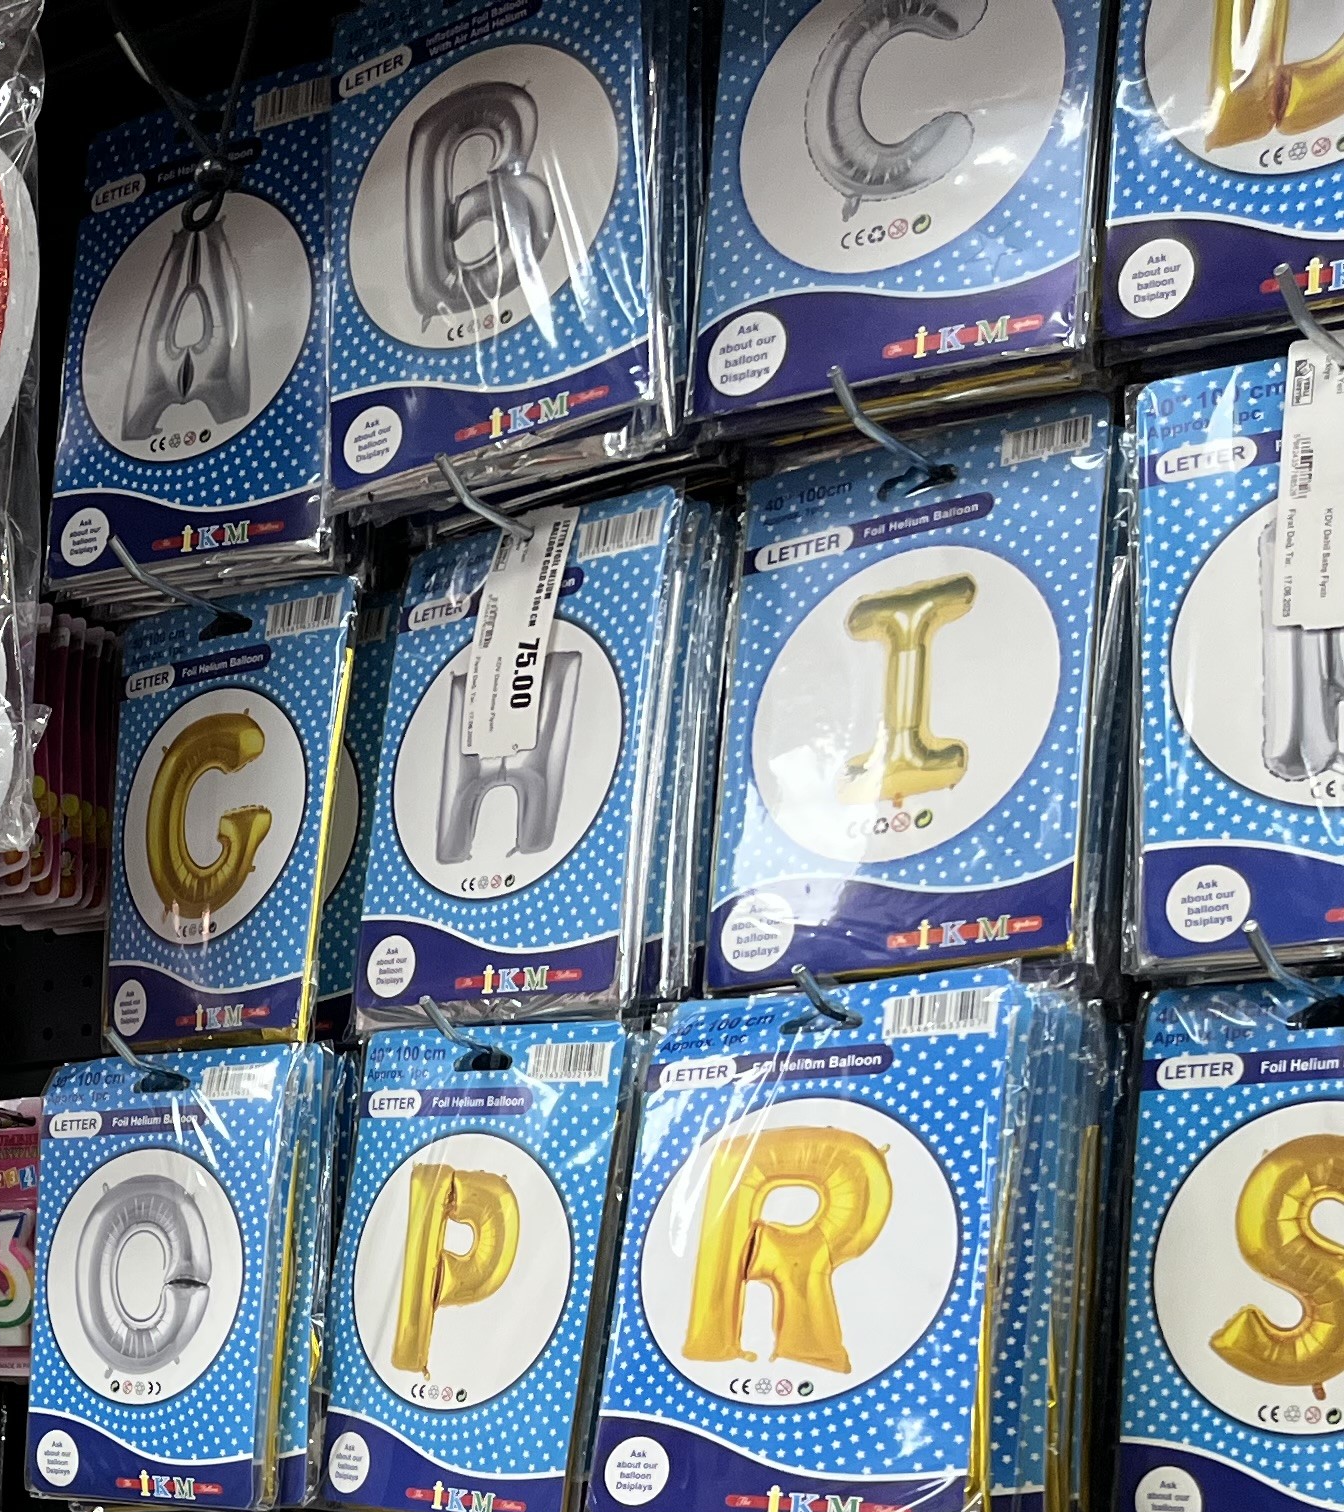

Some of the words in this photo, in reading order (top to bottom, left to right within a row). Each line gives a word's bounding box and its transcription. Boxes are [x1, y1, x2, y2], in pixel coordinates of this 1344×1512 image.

[345, 54, 404, 91] LETTER
[805, 0, 990, 221] C
[95, 181, 141, 206] LETTER
[405, 80, 555, 333] B
[1147, 254, 1166, 265] Ask
[1132, 267, 1161, 280] about
[1164, 264, 1181, 274] our
[1137, 276, 1174, 290] balloon
[121, 213, 252, 443] A
[737, 322, 760, 337] Ask
[719, 339, 753, 355] about
[756, 334, 777, 346] our
[724, 351, 768, 369] balloon
[1164, 446, 1245, 474] LETTER
[863, 524, 886, 538] Foil
[888, 513, 930, 533] Helium
[933, 501, 979, 522] Balloon
[766, 533, 841, 566] LETTER
[413, 602, 462, 624] LETTER
[230, 652, 264, 668] Balloon
[129, 672, 169, 692] LETTER
[510, 637, 541, 710] 75.00
[146, 708, 272, 922] G
[395, 1047, 419, 1061] 100
[423, 1049, 446, 1061] cm
[829, 1053, 882, 1068] Balloon
[666, 1064, 728, 1083] LETTER
[1164, 1061, 1234, 1080] LETTER
[1260, 1058, 1287, 1073] Foil
[1290, 1057, 1340, 1071] Helium
[372, 1097, 415, 1111] LETTER
[451, 1095, 484, 1108] Helium
[486, 1094, 525, 1108] Balloon
[53, 1117, 98, 1132] LETTER
[112, 1116, 128, 1127] Foil
[130, 1113, 161, 1126] Helium
[682, 1126, 893, 1374] R
[1208, 1133, 1344, 1388] S
[391, 1162, 520, 1379] P
[630, 1448, 648, 1460] Ask
[616, 1460, 641, 1471] about
[643, 1460, 658, 1470] our
[619, 1471, 652, 1482] balloon
